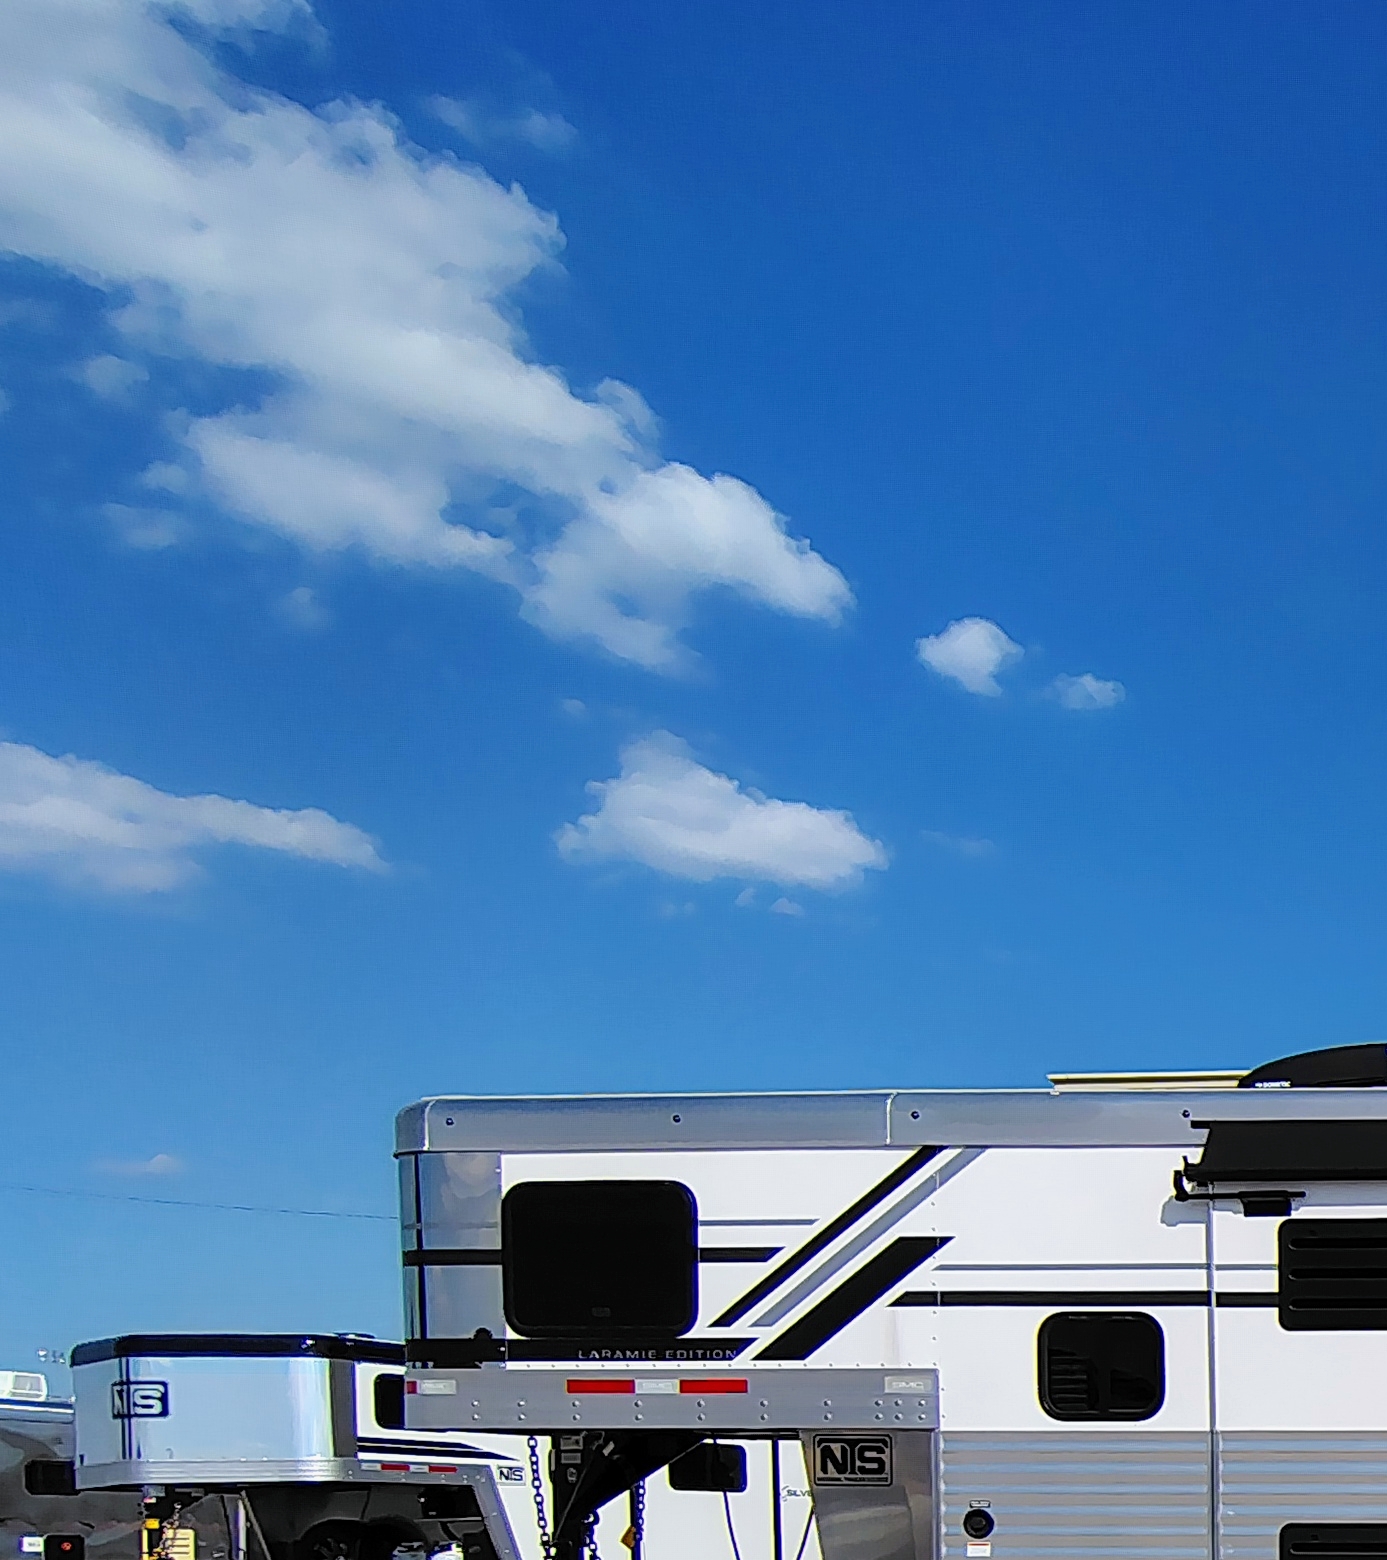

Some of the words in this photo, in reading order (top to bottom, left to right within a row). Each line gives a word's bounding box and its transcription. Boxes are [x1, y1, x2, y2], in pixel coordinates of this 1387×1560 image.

[578, 1349, 657, 1359] LARAMIE
[665, 1349, 737, 1359] EDITION
[817, 1437, 889, 1475] NTS
